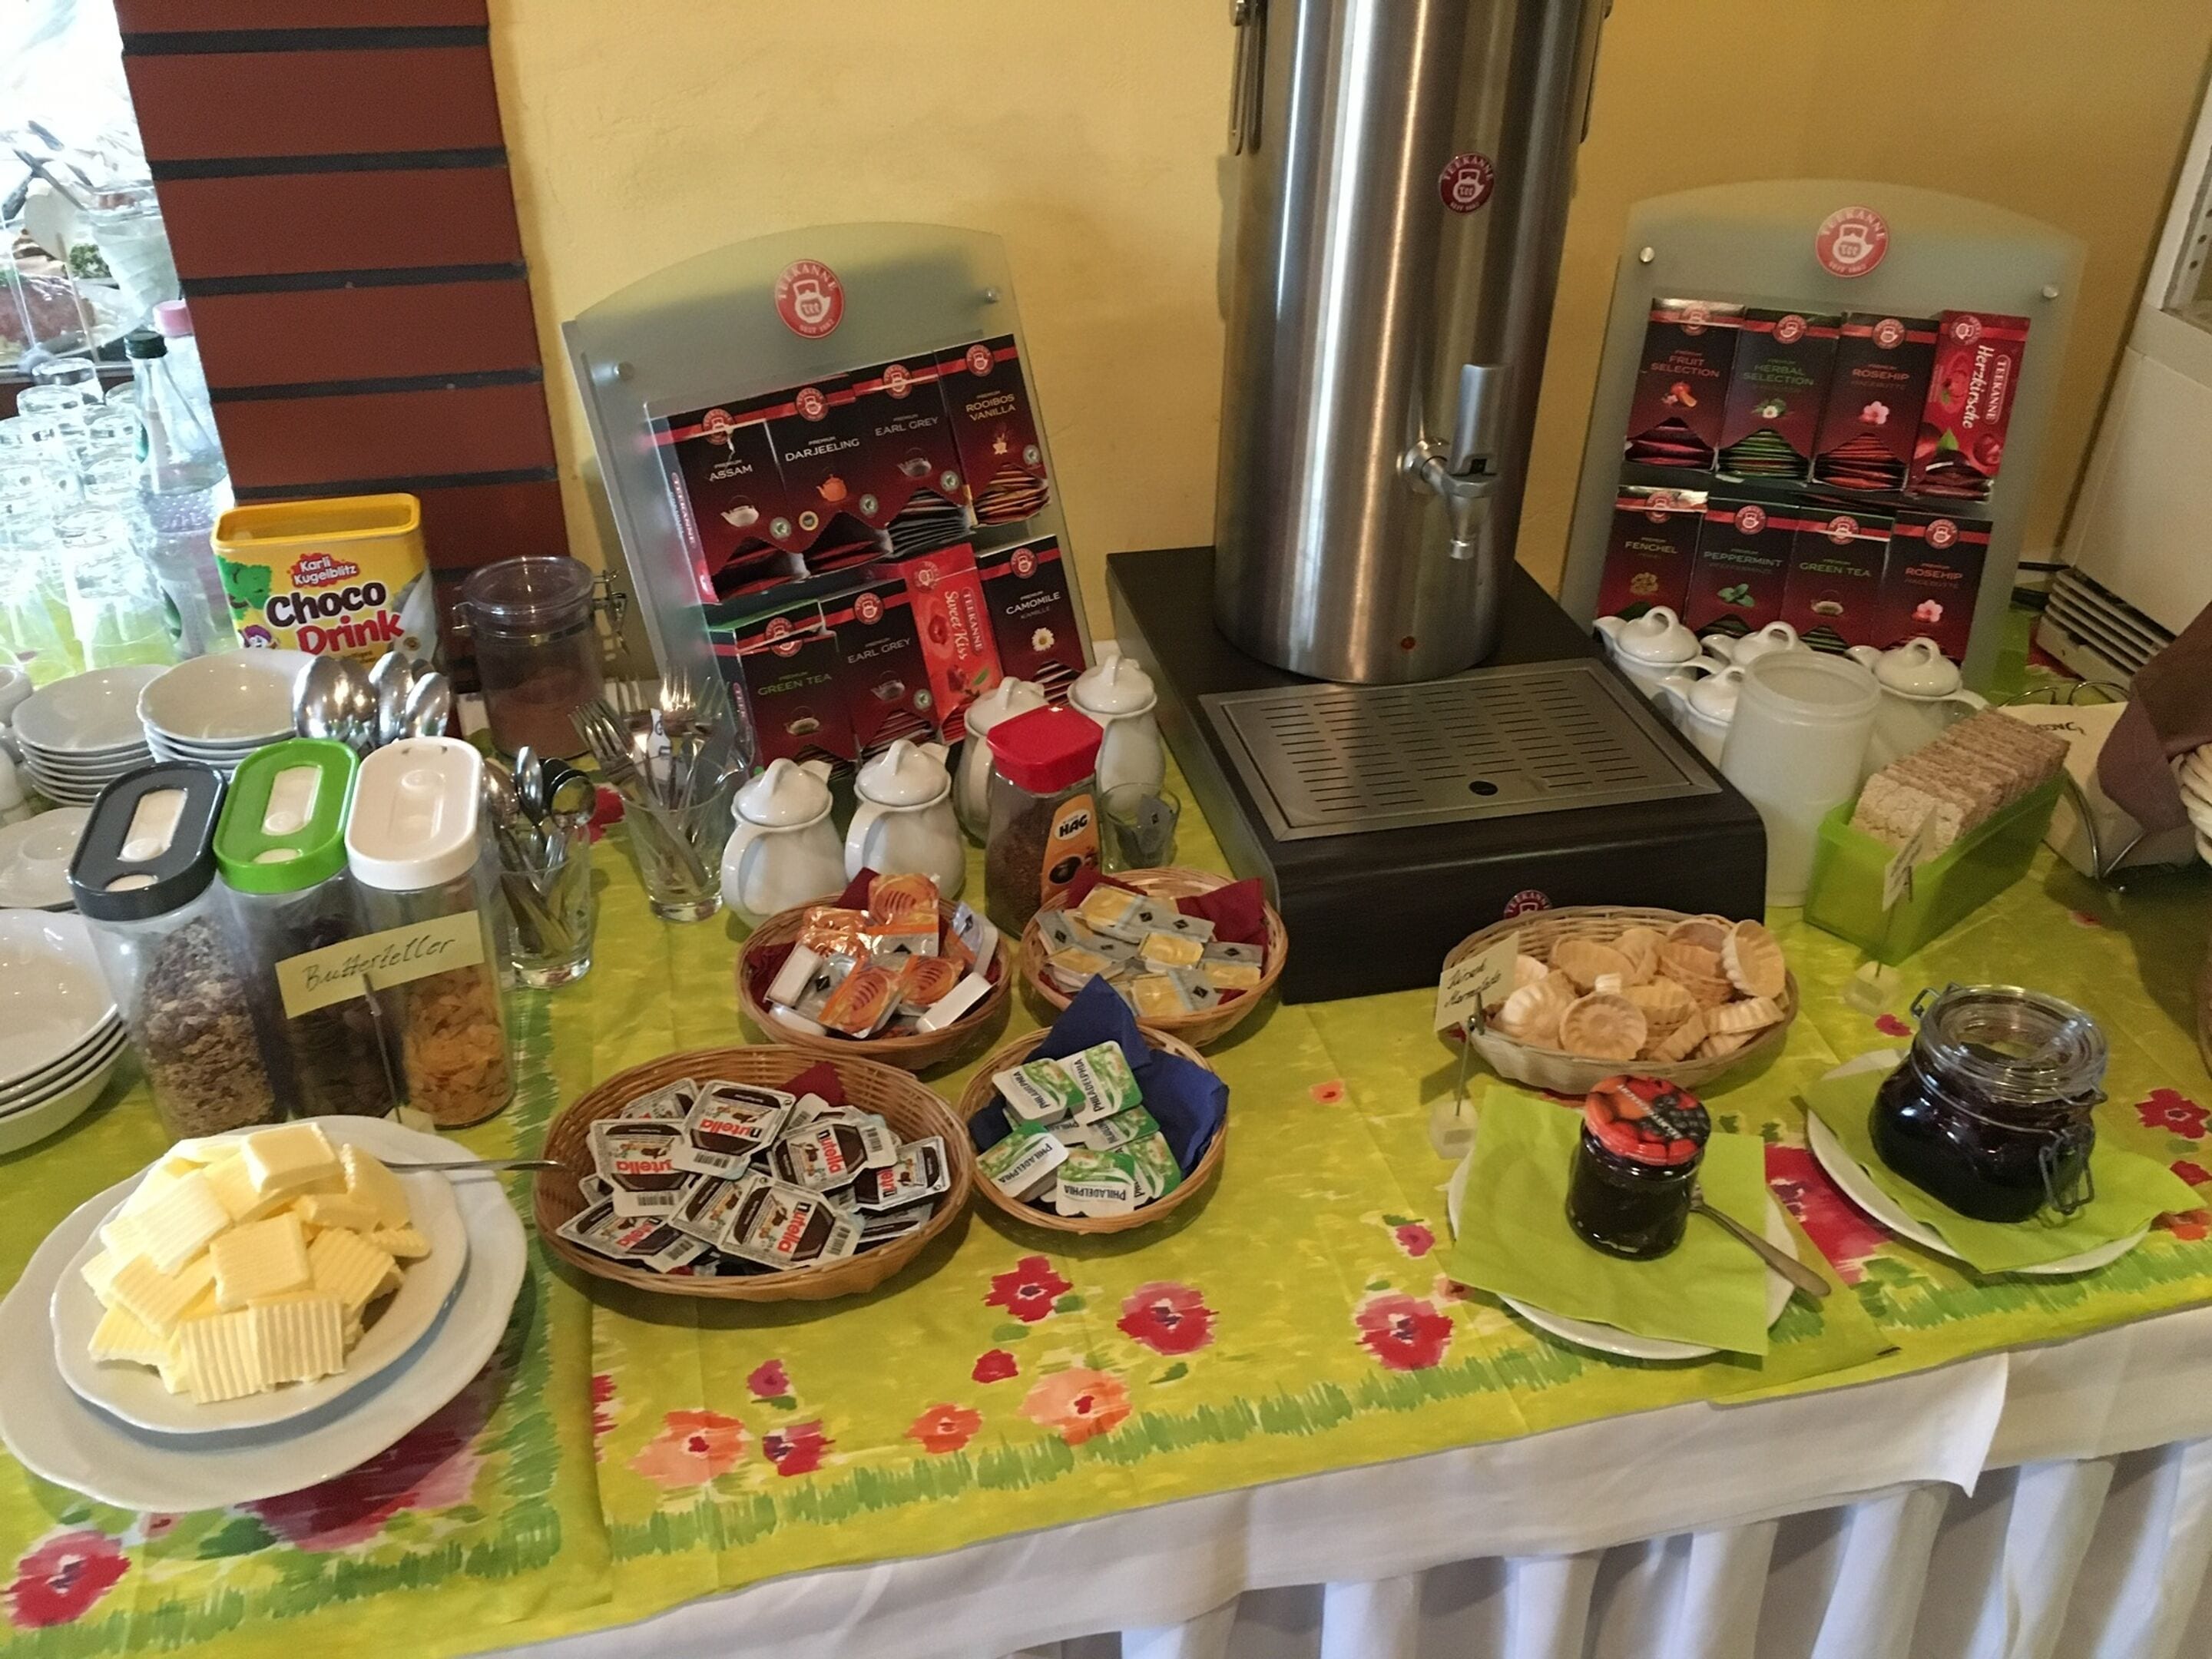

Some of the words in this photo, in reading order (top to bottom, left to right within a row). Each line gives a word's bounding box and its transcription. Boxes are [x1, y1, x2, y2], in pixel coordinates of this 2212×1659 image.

[1443, 155, 1494, 181] TEEKANNE
[1820, 209, 1886, 241] TEEKANNE
[778, 263, 838, 300] TEEKANNE
[1651, 362, 1720, 378] SELECTION
[1669, 354, 1704, 366] FRUIT
[1754, 364, 1805, 376] HERBAL
[1743, 372, 1814, 386] SELECTION
[1852, 368, 1909, 381] ROSEHIP
[1962, 345, 1995, 429] Herzkirsche
[1985, 359, 2007, 420] TEEKANNE
[965, 393, 1015, 412] ROOIBOS
[969, 404, 1016, 422] VANILLA
[875, 424, 907, 437] EARL
[909, 416, 939, 430] GREY
[785, 438, 860, 462] DARJEELING
[709, 463, 753, 483] ASSAM
[674, 476, 696, 545] TEEKANNE
[1624, 541, 1678, 555] FENCHEL
[1704, 551, 1783, 568] PEPPERMINT
[293, 565, 357, 586] Kugelblitz
[300, 555, 332, 573] Karli
[1799, 561, 1843, 574] GREEN
[1847, 567, 1871, 577] TEA
[1905, 567, 1963, 580] ROSEHIP
[266, 582, 386, 628] Choco
[1005, 591, 1061, 615] CAMOMILE
[296, 611, 405, 656] Drink
[944, 591, 961, 629] Sweet
[955, 629, 969, 661] Kiss
[963, 593, 984, 651] TEEKANNE
[847, 650, 879, 664] EARL
[881, 637, 911, 654] GREY
[757, 679, 804, 696] GREEN
[806, 673, 833, 685] TEA
[1059, 814, 1088, 837] HAG
[302, 935, 457, 992] Butterteller
[1013, 1070, 1051, 1110] PHILADELPHIA
[1074, 1058, 1105, 1113] PHILADELPHIA
[700, 1118, 763, 1139] nutella
[817, 1129, 846, 1174] nutella
[998, 1142, 1054, 1184] PHILADELPHIA
[616, 1158, 673, 1174] utella
[1064, 1184, 1126, 1201] PHILADELPHIA
[777, 1200, 812, 1253] nutella
